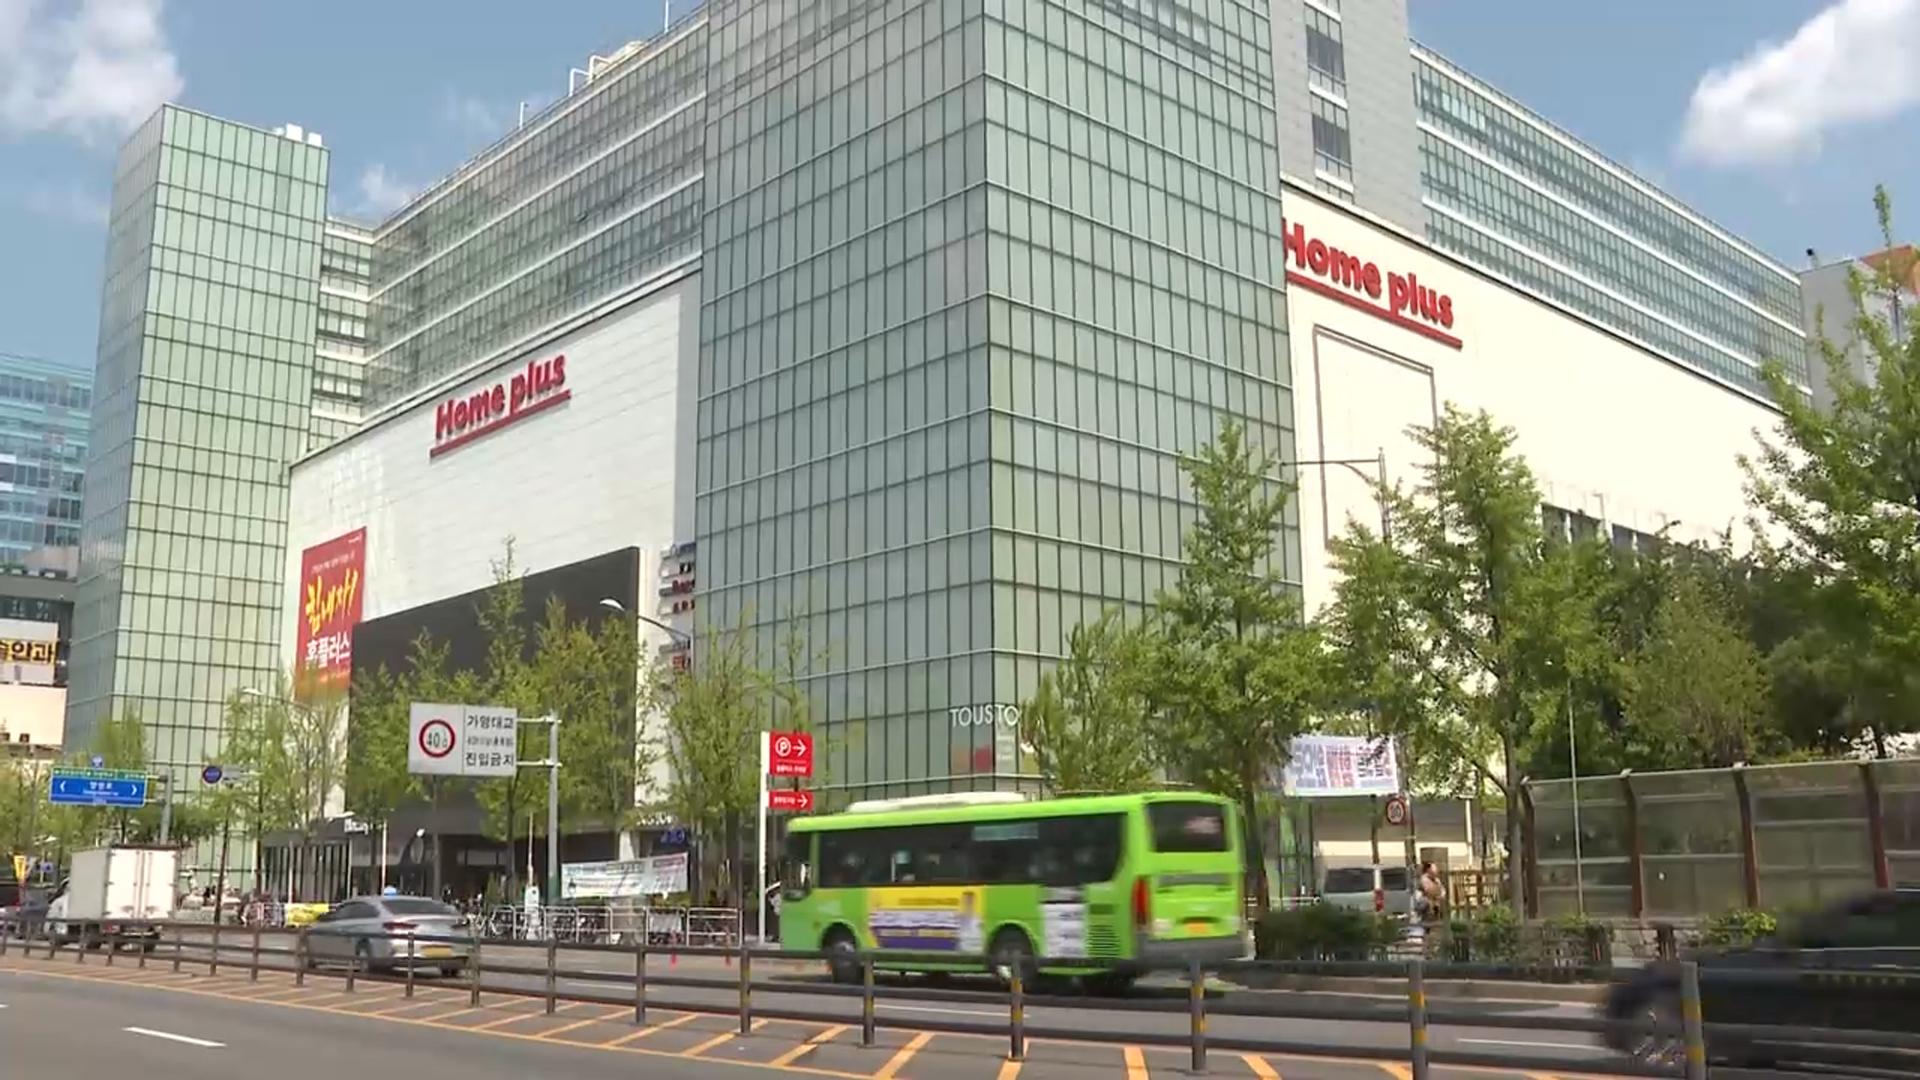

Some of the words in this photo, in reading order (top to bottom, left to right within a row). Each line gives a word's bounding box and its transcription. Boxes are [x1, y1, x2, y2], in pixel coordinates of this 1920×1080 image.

[1281, 217, 1381, 299] Home
[1387, 271, 1454, 329] plus
[435, 384, 506, 440] Home
[510, 354, 566, 415] plus
[465, 752, 514, 767] 진입금지
